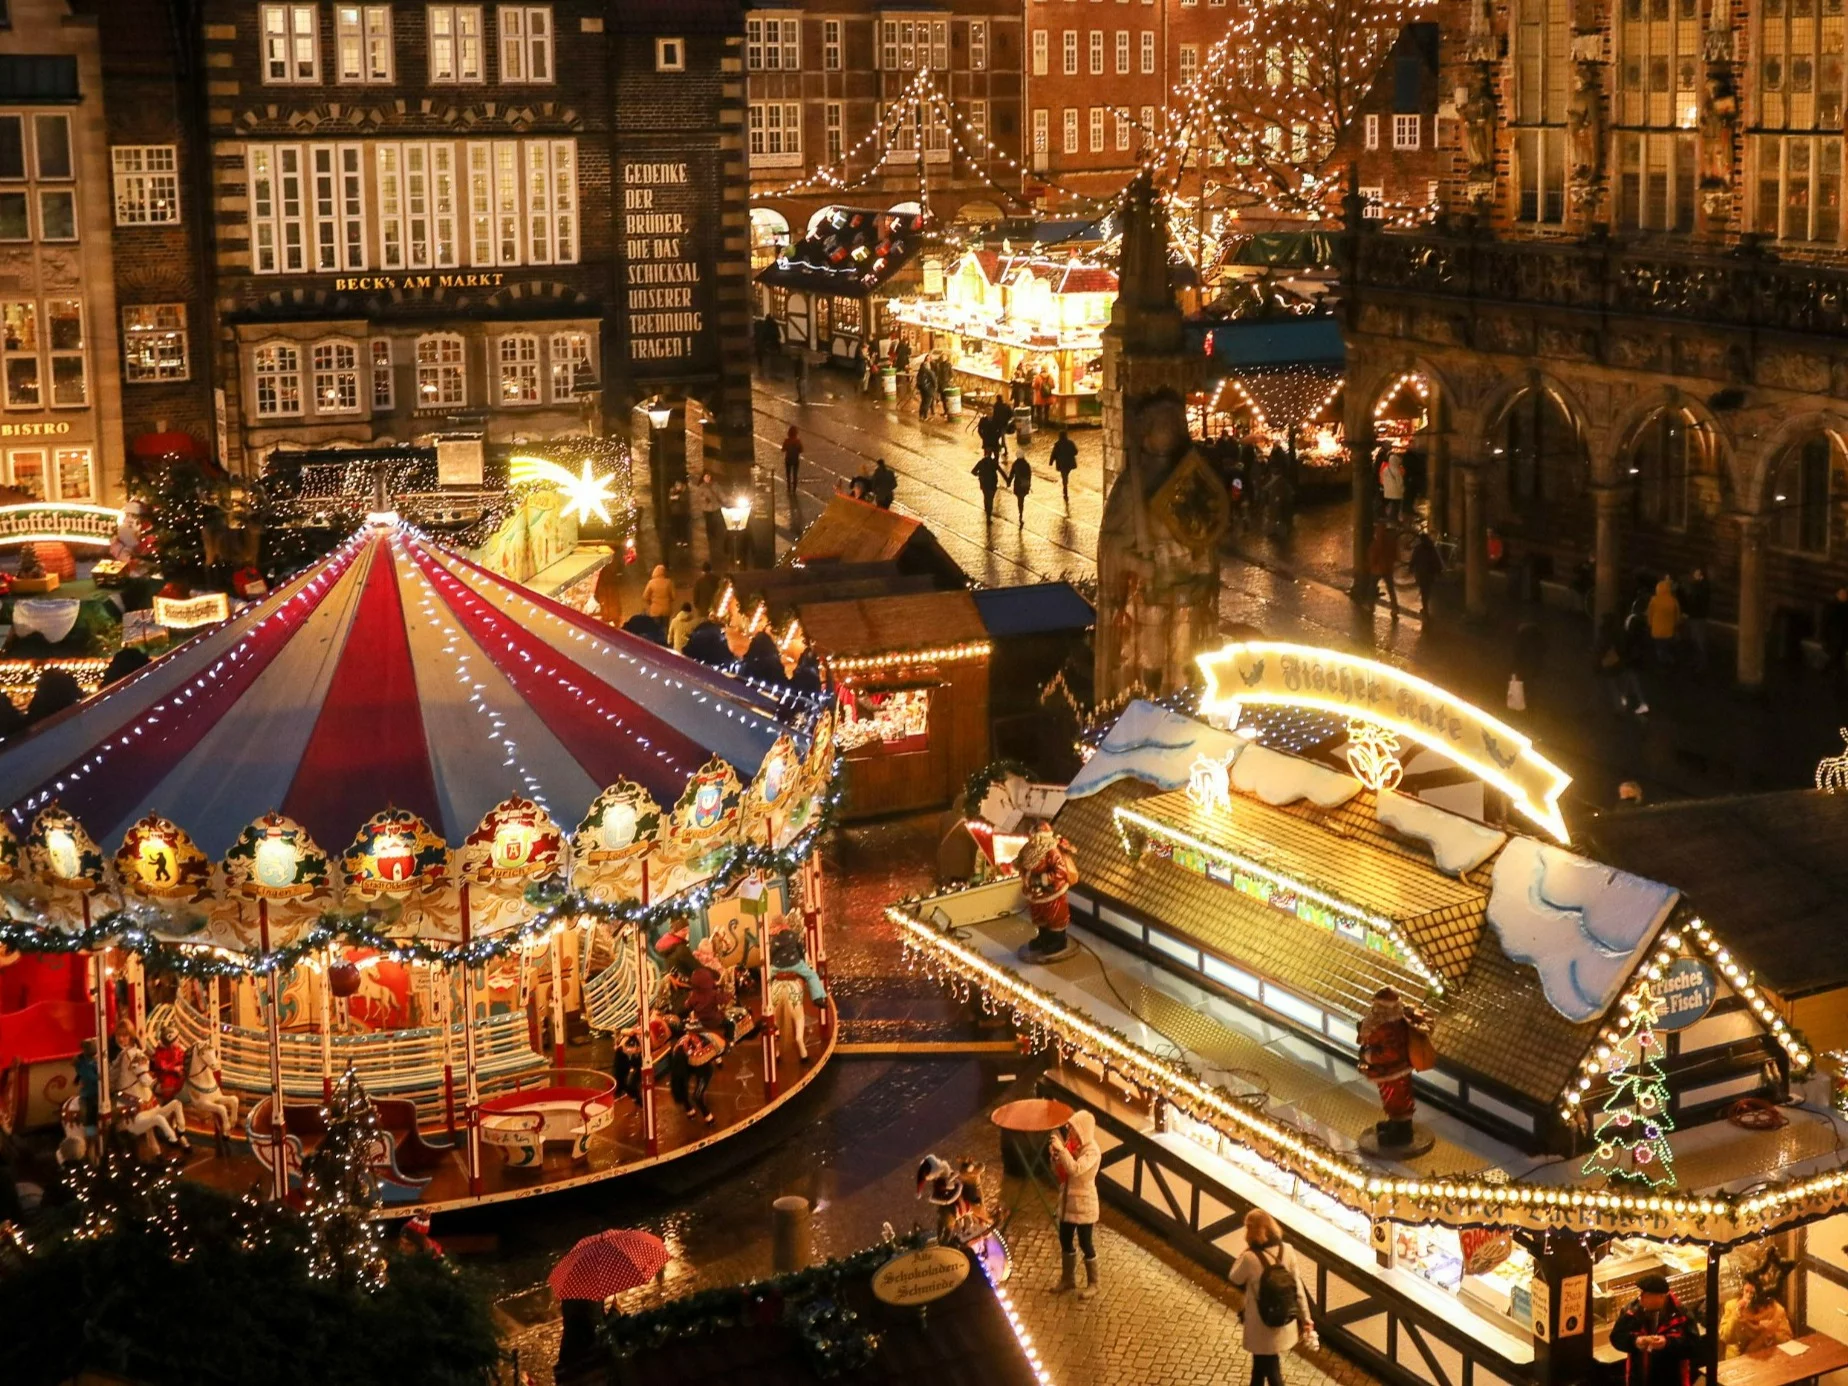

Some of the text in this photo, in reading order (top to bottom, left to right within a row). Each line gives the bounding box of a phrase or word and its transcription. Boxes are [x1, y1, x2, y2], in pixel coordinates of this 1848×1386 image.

[625, 163, 687, 184] GEDENKE
[625, 189, 653, 209] DER
[626, 210, 690, 234] BRÜDER,
[627, 238, 680, 259] DIE DAS
[403, 276, 431, 289] AM
[439, 273, 503, 287] MARKT
[628, 262, 700, 284] SCHICKSAL
[629, 288, 691, 309] UNSERER
[630, 312, 703, 334] TRENNUNG
[1, 422, 70, 436] BISTRO
[489, 867, 526, 877] Aurich
[362, 880, 384, 890] Stadt
